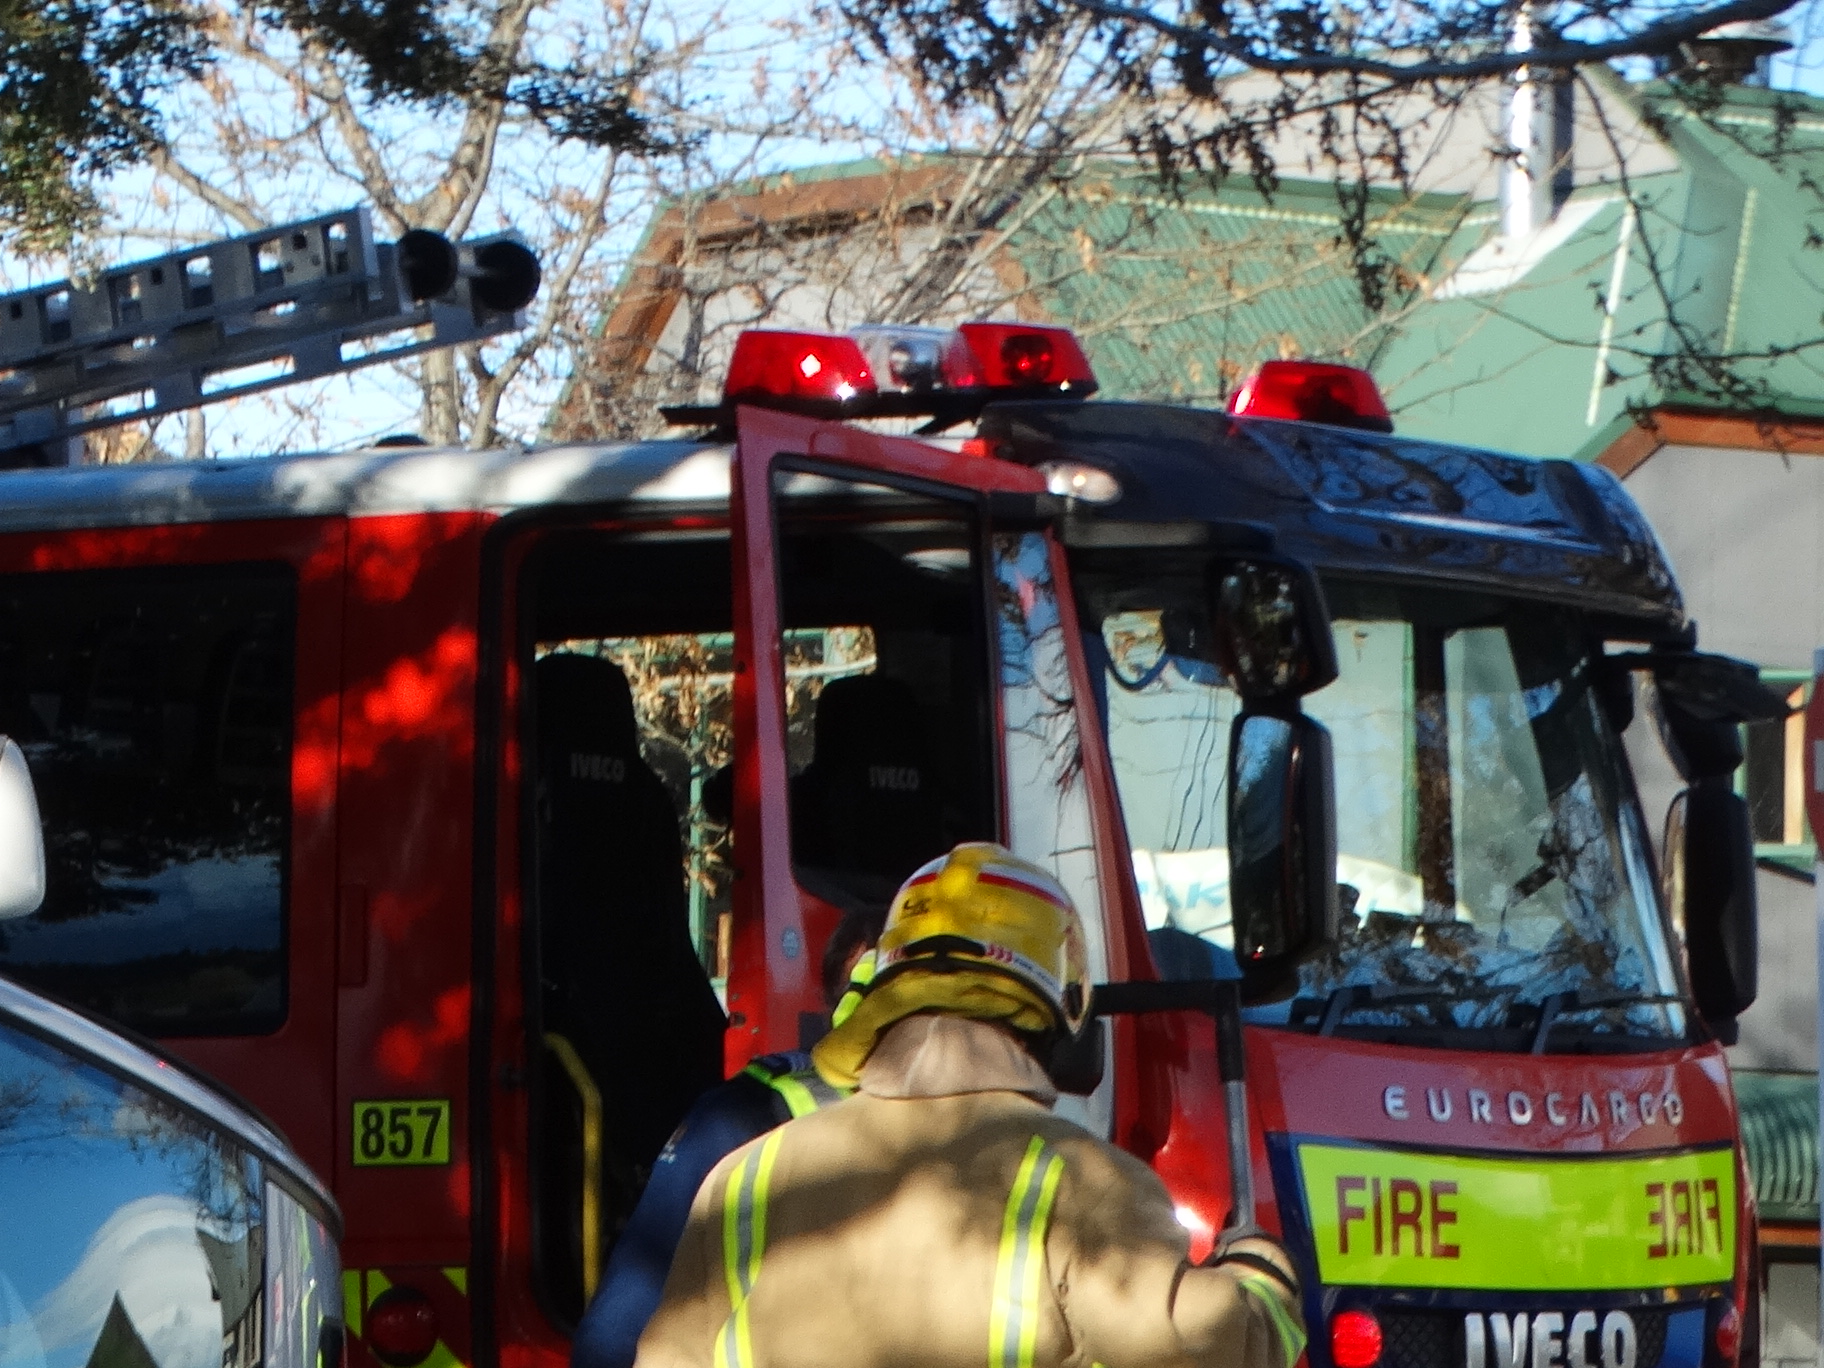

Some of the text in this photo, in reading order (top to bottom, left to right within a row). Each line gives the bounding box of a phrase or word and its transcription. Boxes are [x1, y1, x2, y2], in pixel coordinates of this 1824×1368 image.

[1382, 1084, 1684, 1126] EUROCARGO
[360, 1106, 443, 1160] 857
[1336, 1175, 1460, 1259] FIRE
